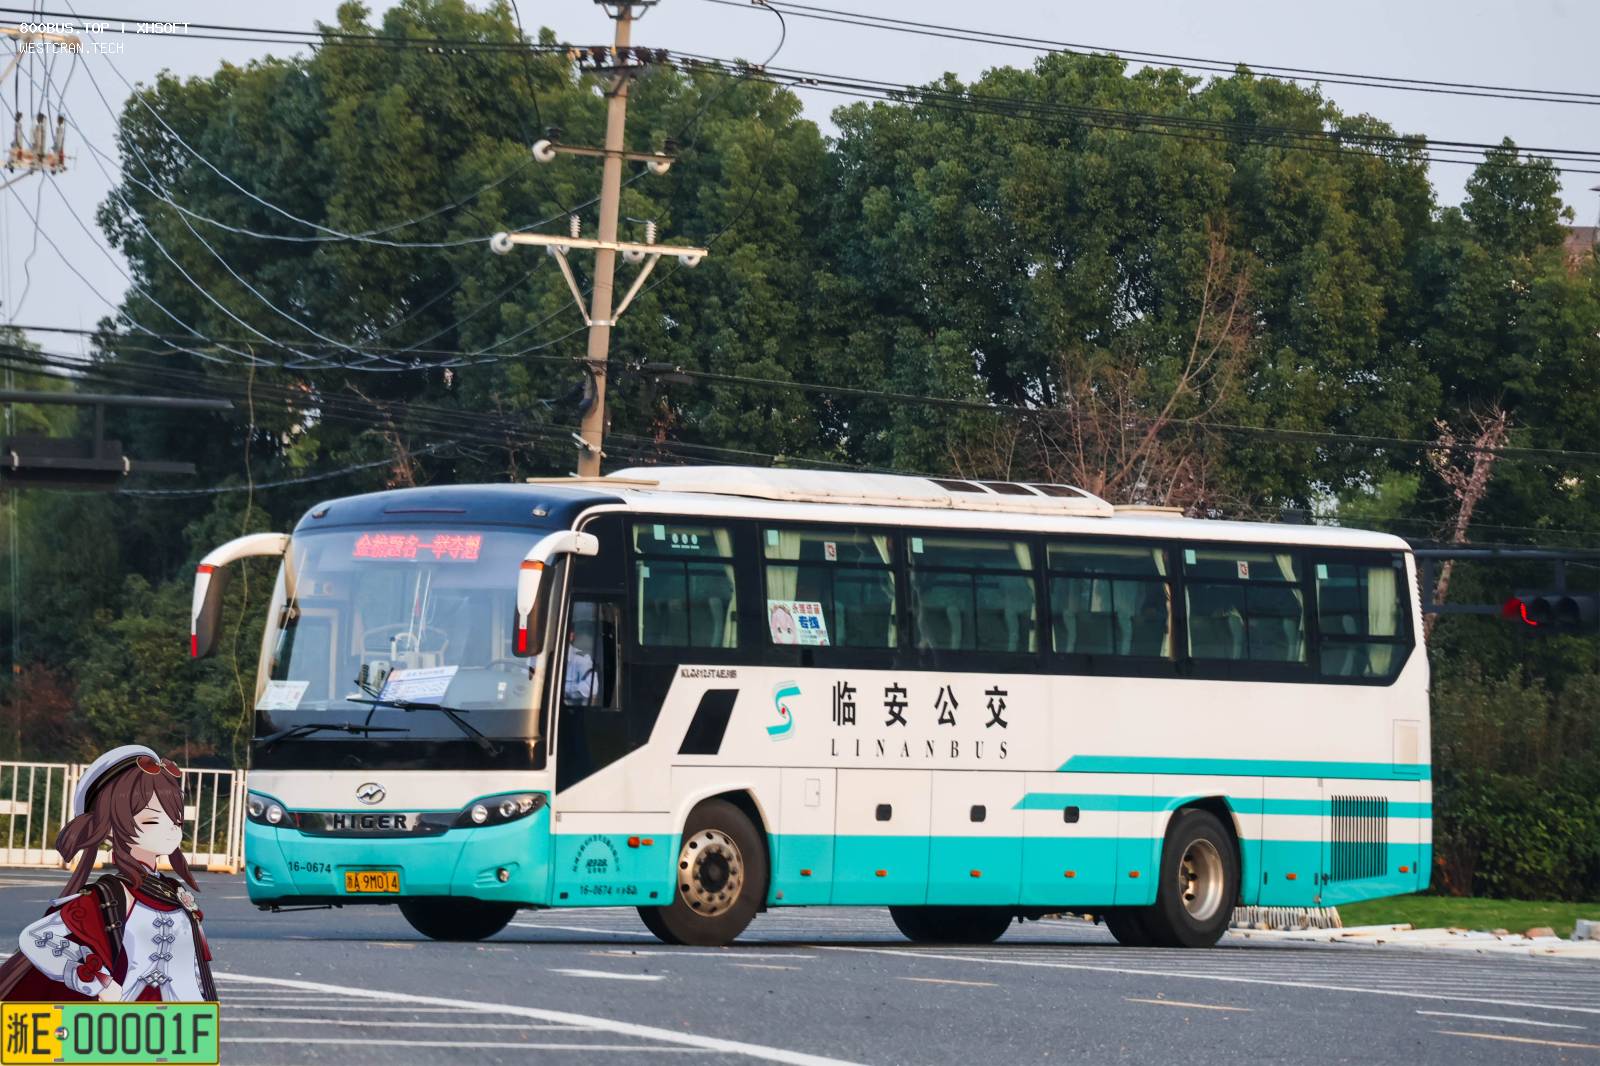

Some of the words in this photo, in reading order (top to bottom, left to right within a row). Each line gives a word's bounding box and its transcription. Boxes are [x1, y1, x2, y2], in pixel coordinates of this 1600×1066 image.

[832, 681, 1009, 729] 临安公交
[333, 813, 408, 831] HIGER
[288, 861, 332, 874] 16-0674
